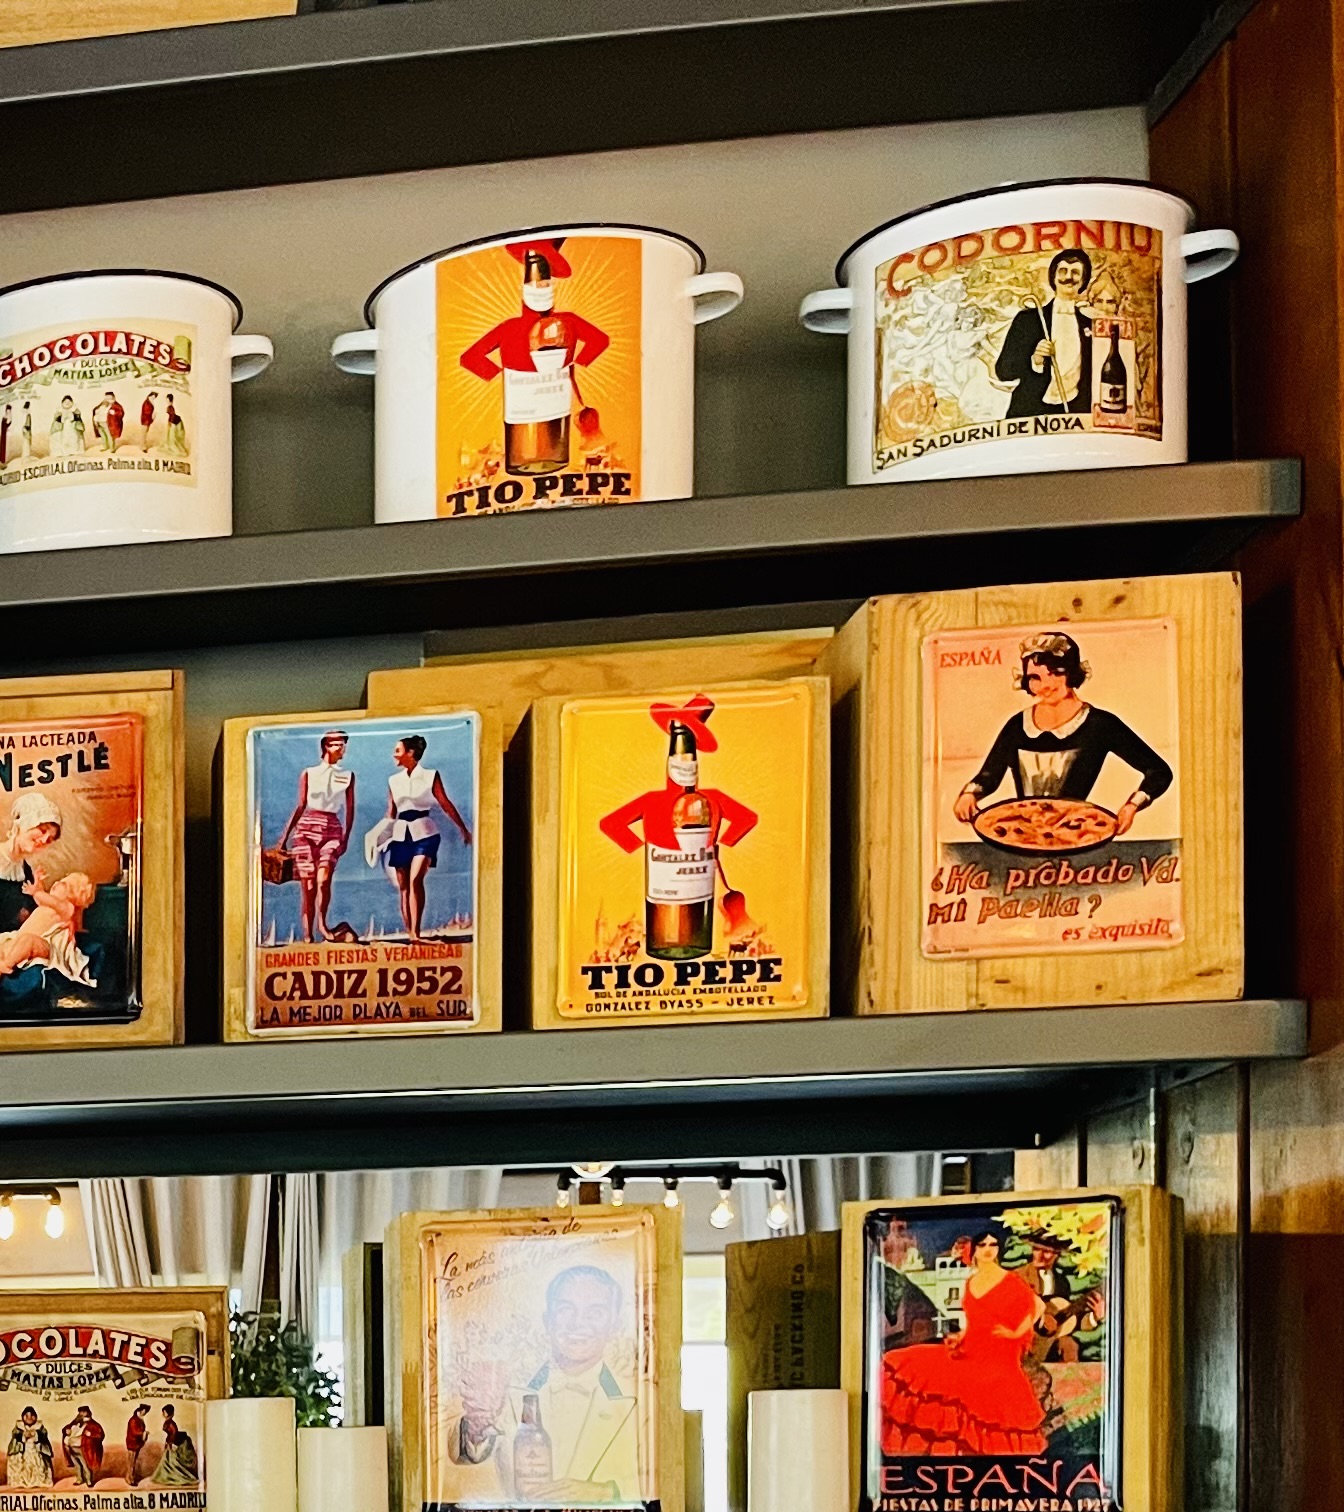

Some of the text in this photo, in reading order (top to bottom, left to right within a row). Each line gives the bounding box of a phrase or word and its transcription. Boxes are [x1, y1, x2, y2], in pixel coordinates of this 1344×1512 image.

[876, 446, 908, 470] SAN
[1006, 421, 1029, 436] DE
[1032, 415, 1085, 435] NOYA
[446, 480, 524, 516] TIO
[532, 472, 632, 500] PEPE
[939, 645, 1003, 669] ESPAÑA
[22, 730, 98, 749] LACTEADA
[1061, 925, 1082, 943] es
[265, 950, 320, 970] GRANDES
[326, 947, 378, 966] FIESTAS
[264, 965, 463, 1003] CADIZ 1952
[581, 957, 783, 991] TIO PEPE
[259, 999, 469, 1027] LA MEJOR PLAYA DEL SUR
[585, 1000, 652, 1014] GONZALEZ
[725, 995, 776, 1008] JEREZ
[12, 1367, 112, 1389] MATIAS LOPEZ
[33, 1362, 93, 1374] Y DULCES
[880, 1456, 1109, 1498] ESPAÑA
[83, 1494, 121, 1511] Palma
[148, 1493, 156, 1510] 8
[944, 1499, 966, 1512] DE
[970, 1498, 1072, 1512] PRIMAVERA
